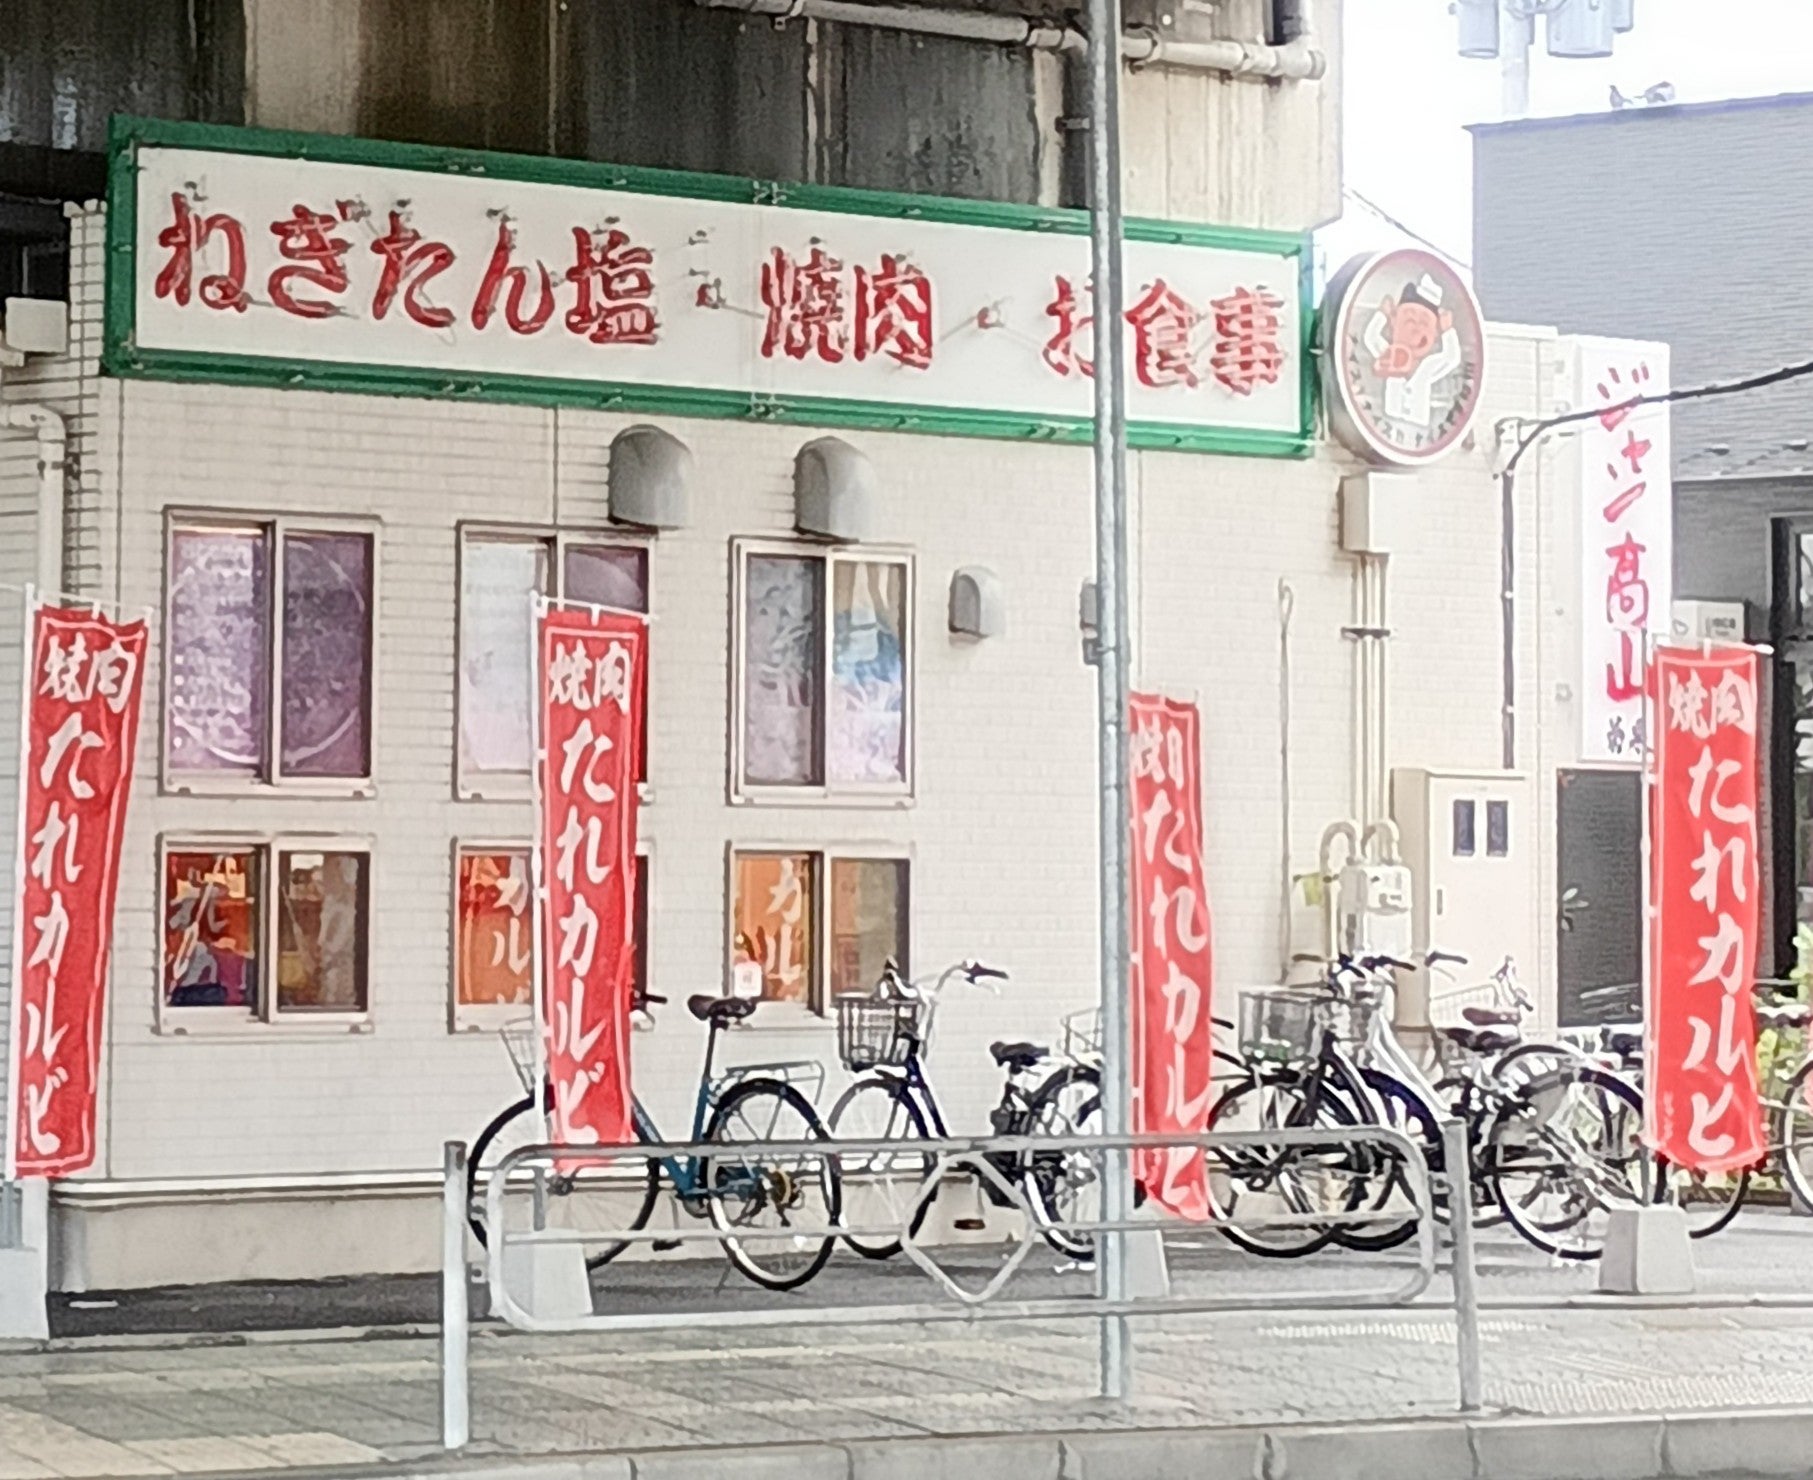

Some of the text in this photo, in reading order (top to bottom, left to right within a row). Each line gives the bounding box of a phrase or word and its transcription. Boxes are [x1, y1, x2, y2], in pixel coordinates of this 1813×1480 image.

[38, 631, 138, 715] 焼肉
[548, 637, 632, 715] 焼肉
[1668, 668, 1754, 740] 焼肉
[25, 711, 106, 1156] たれカルビ
[556, 717, 616, 1144] たれカルビ
